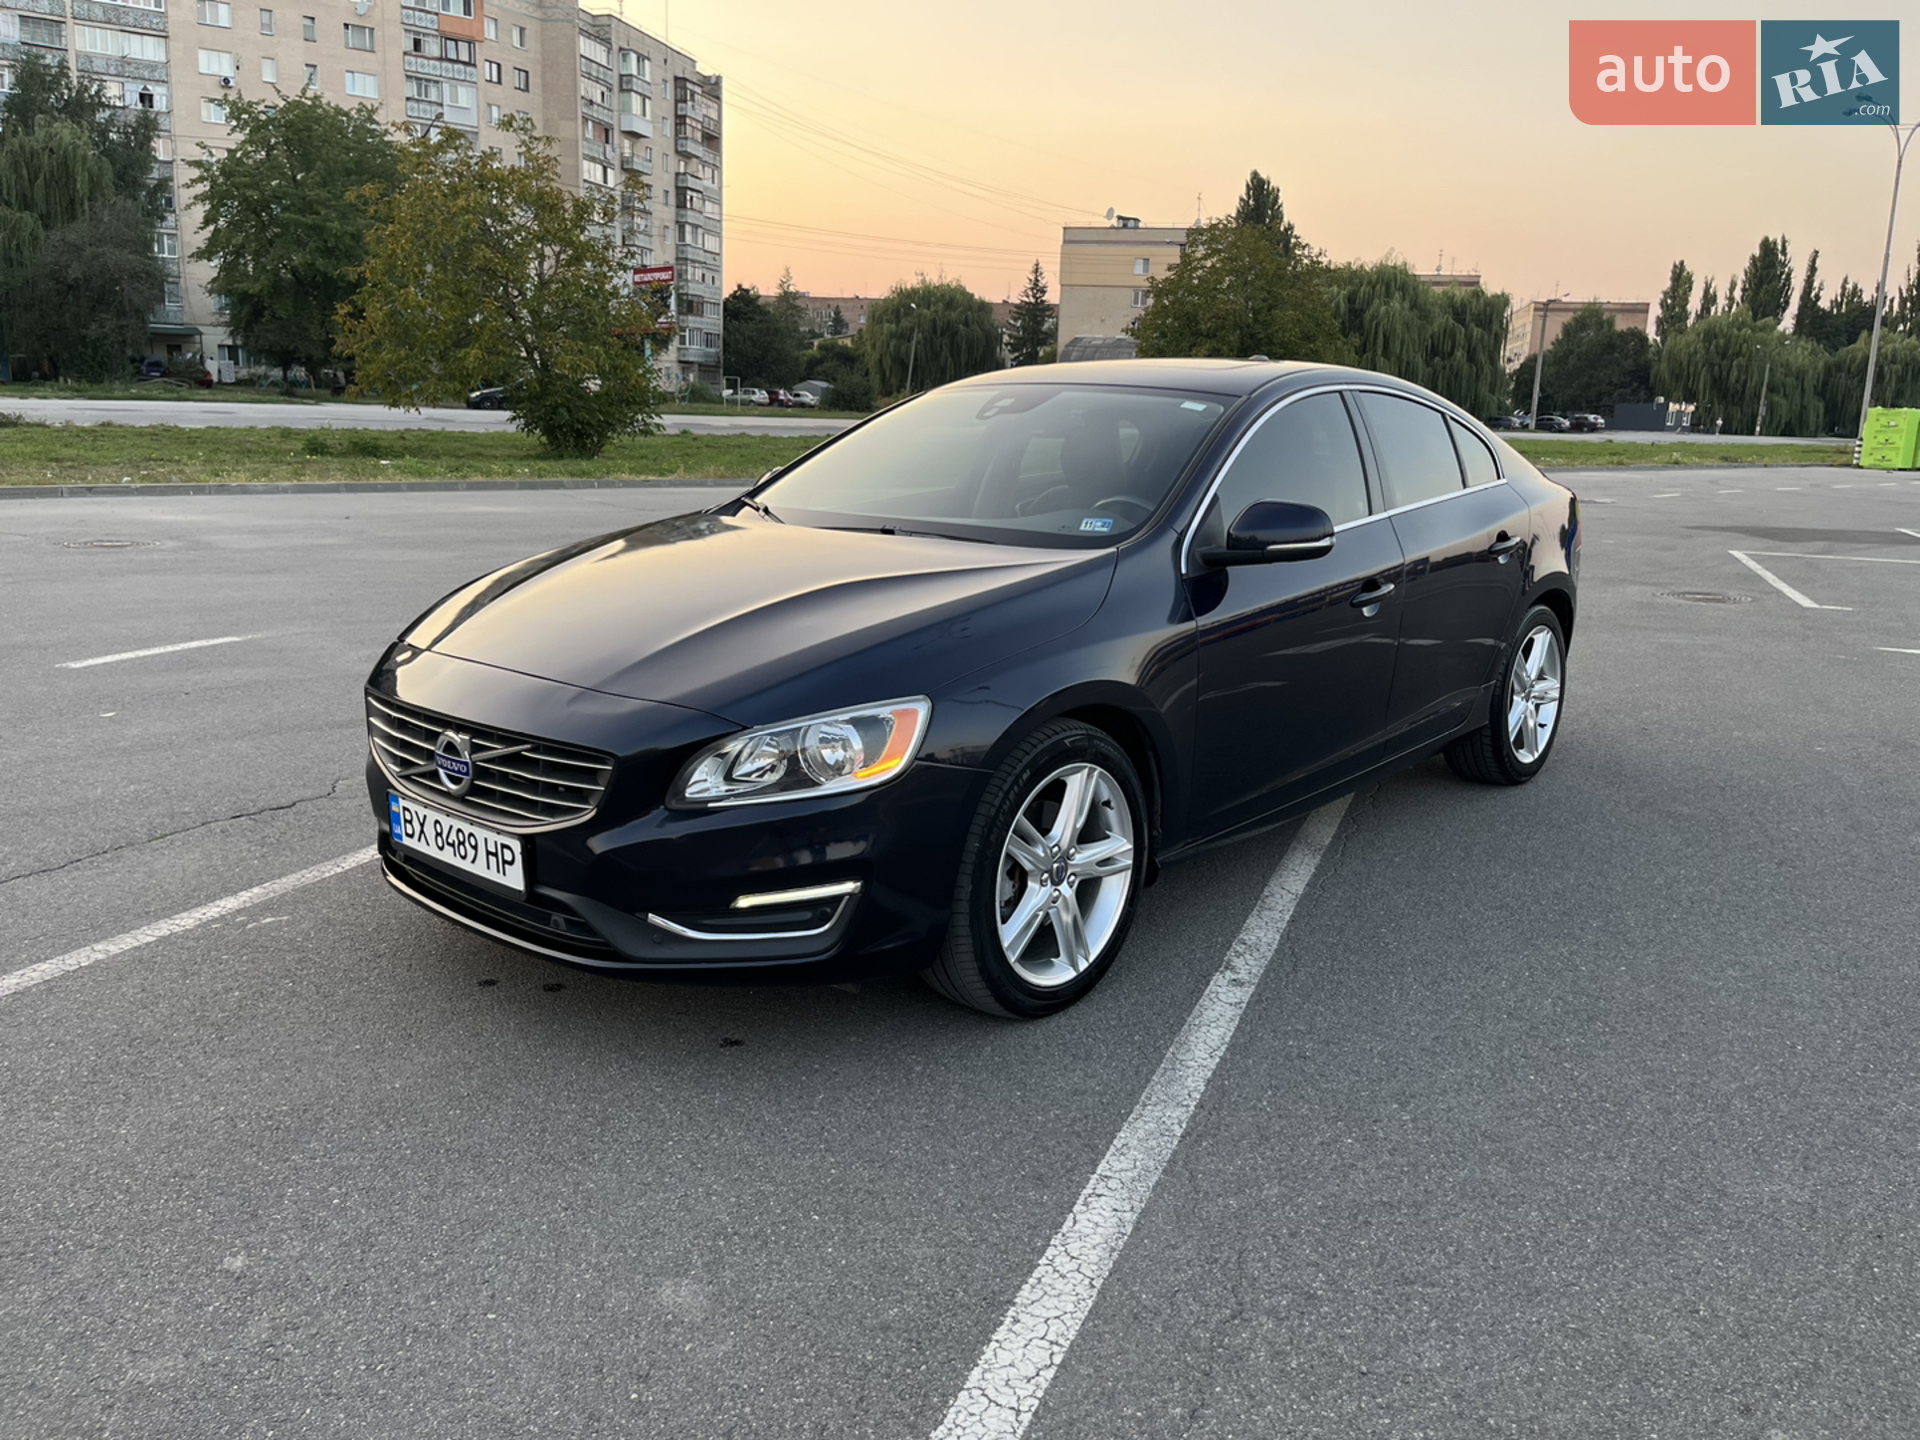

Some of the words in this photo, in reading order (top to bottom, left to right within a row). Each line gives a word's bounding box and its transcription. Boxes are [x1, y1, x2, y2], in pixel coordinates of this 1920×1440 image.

[436, 756, 468, 773] VOLVO
[402, 805, 430, 847] BX
[433, 819, 479, 864] 8489
[484, 836, 516, 877] HP
